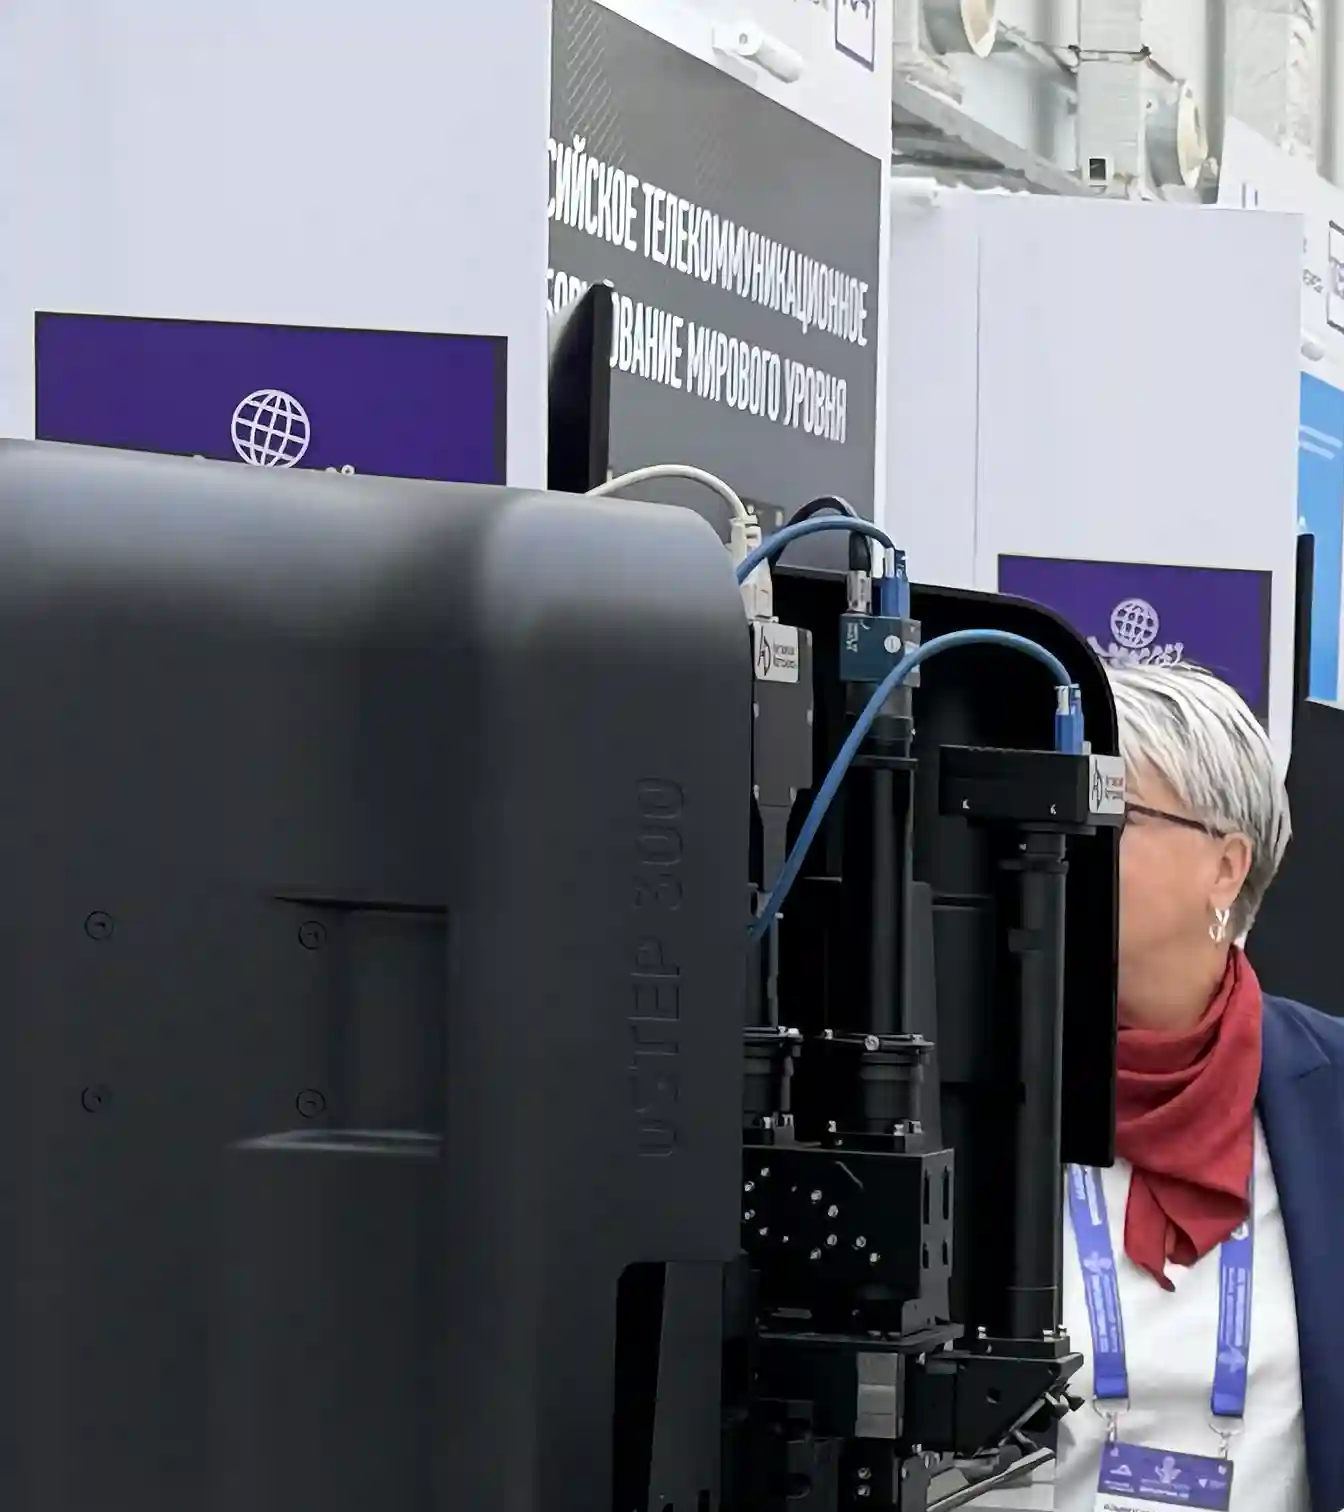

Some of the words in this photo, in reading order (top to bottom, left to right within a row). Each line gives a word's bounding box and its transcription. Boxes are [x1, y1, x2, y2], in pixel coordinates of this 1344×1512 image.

[641, 181, 869, 347] ТЕЛЕКОММУНИКАЦИОННОЕ
[686, 321, 781, 422] МИРОВОГО
[782, 357, 848, 444] УРОВНЯ
[633, 776, 684, 911] 300
